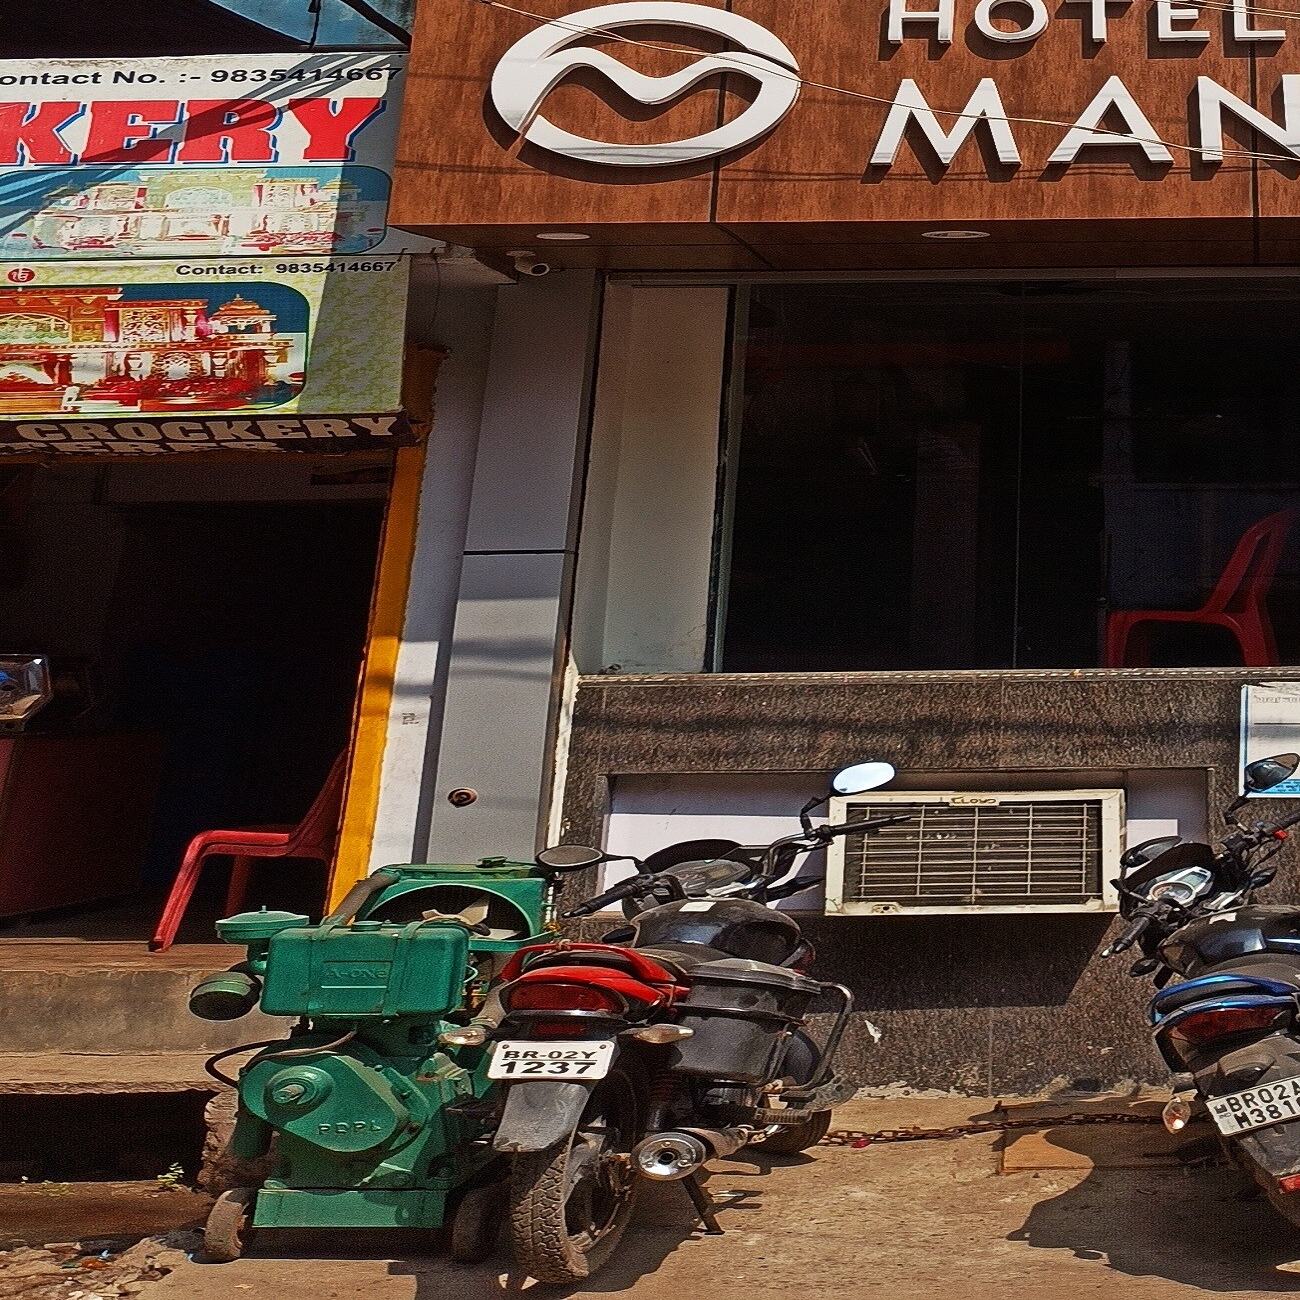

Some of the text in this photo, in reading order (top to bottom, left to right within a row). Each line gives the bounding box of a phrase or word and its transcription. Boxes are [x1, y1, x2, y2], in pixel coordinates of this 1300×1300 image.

[113, 70, 166, 85] No.
[210, 67, 403, 83] 9835414667
[176, 261, 397, 276] Contact: 9835414667
[15, 416, 399, 441] CROCKERY
[503, 1050, 598, 1059] BR-02Y
[500, 1061, 597, 1075] 1237
